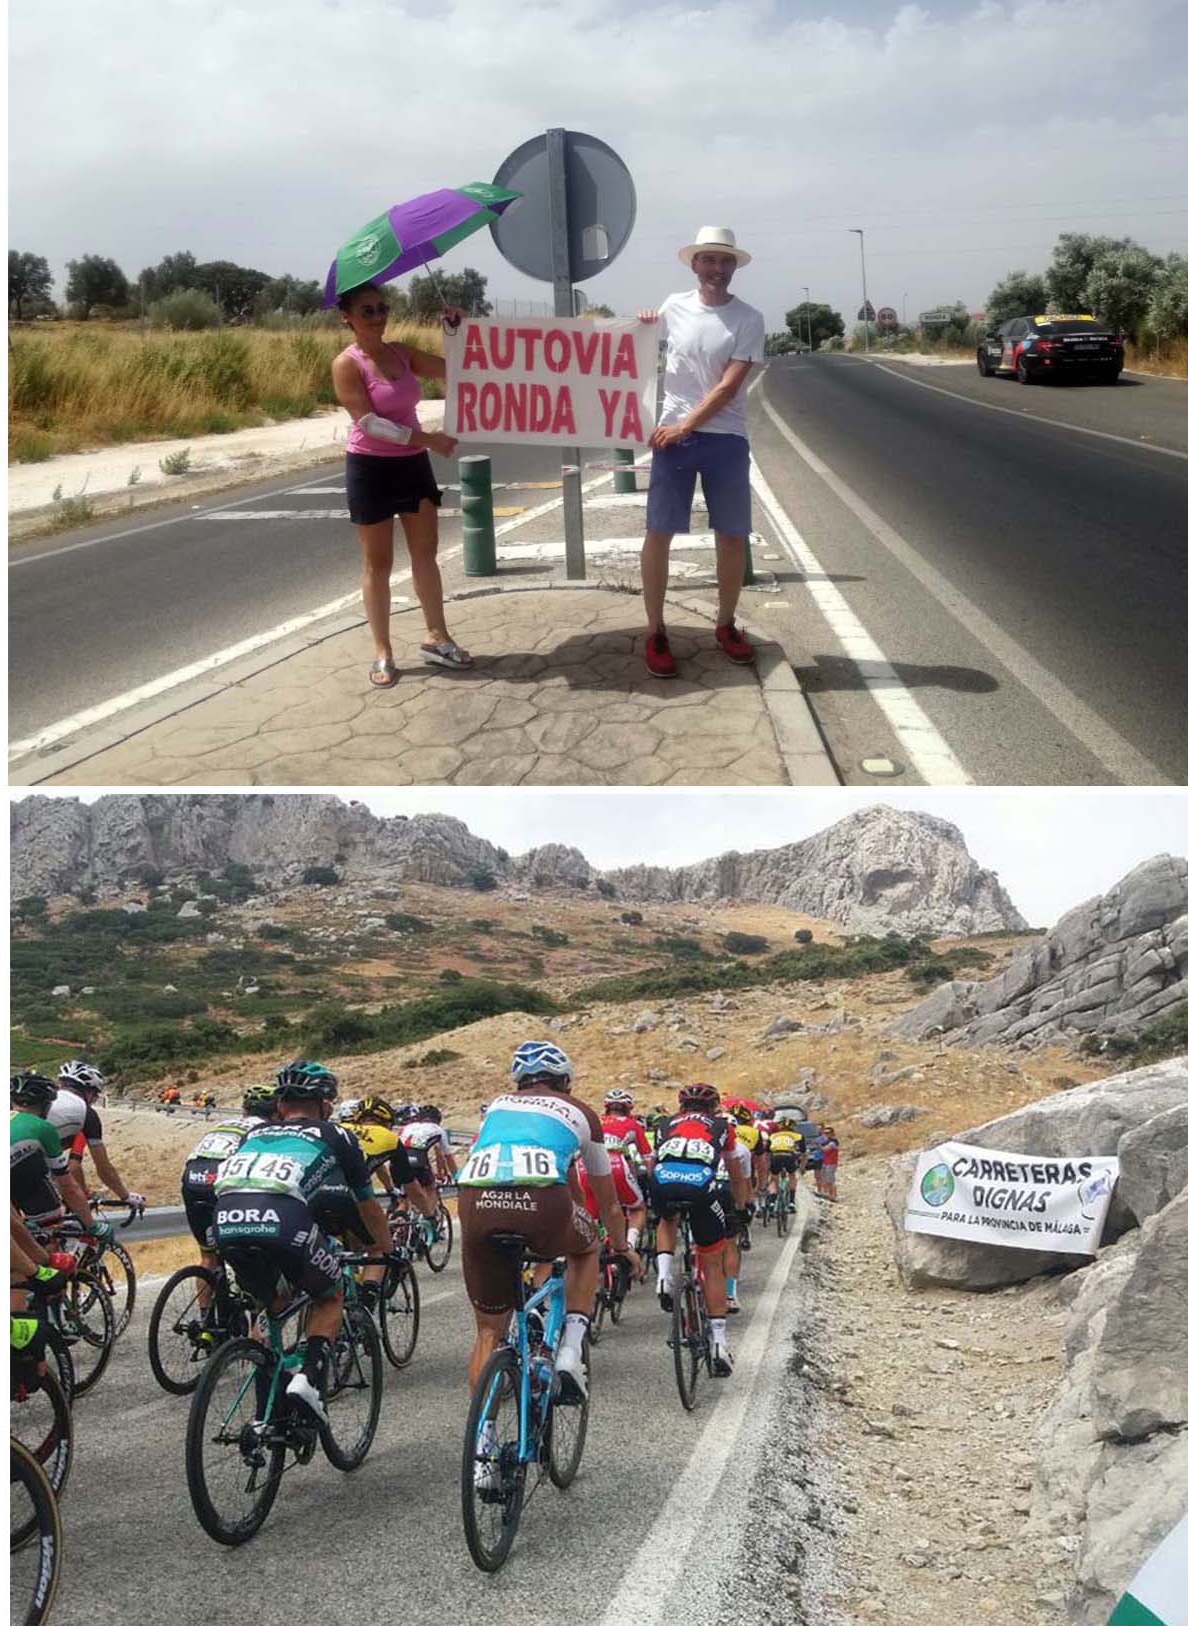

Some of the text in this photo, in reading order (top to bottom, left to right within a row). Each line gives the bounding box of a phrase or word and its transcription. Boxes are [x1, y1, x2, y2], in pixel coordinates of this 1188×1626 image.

[462, 324, 638, 380] AUTOVIA
[456, 382, 644, 443] RONDA YA
[260, 1158, 294, 1181] 45
[469, 1151, 550, 1179] 16 16
[659, 1169, 703, 1182] SOPHOS
[952, 1157, 1093, 1185] CARRETERAS
[475, 1200, 538, 1211] MONDIALE
[480, 1190, 532, 1200] AG2R LA
[973, 1186, 1052, 1213] DIGNAS
[217, 1208, 281, 1225] BORA
[940, 1210, 1082, 1235] PARA LA PROVINCIA DE MÁLAGA
[219, 1224, 277, 1236] hansgrohe
